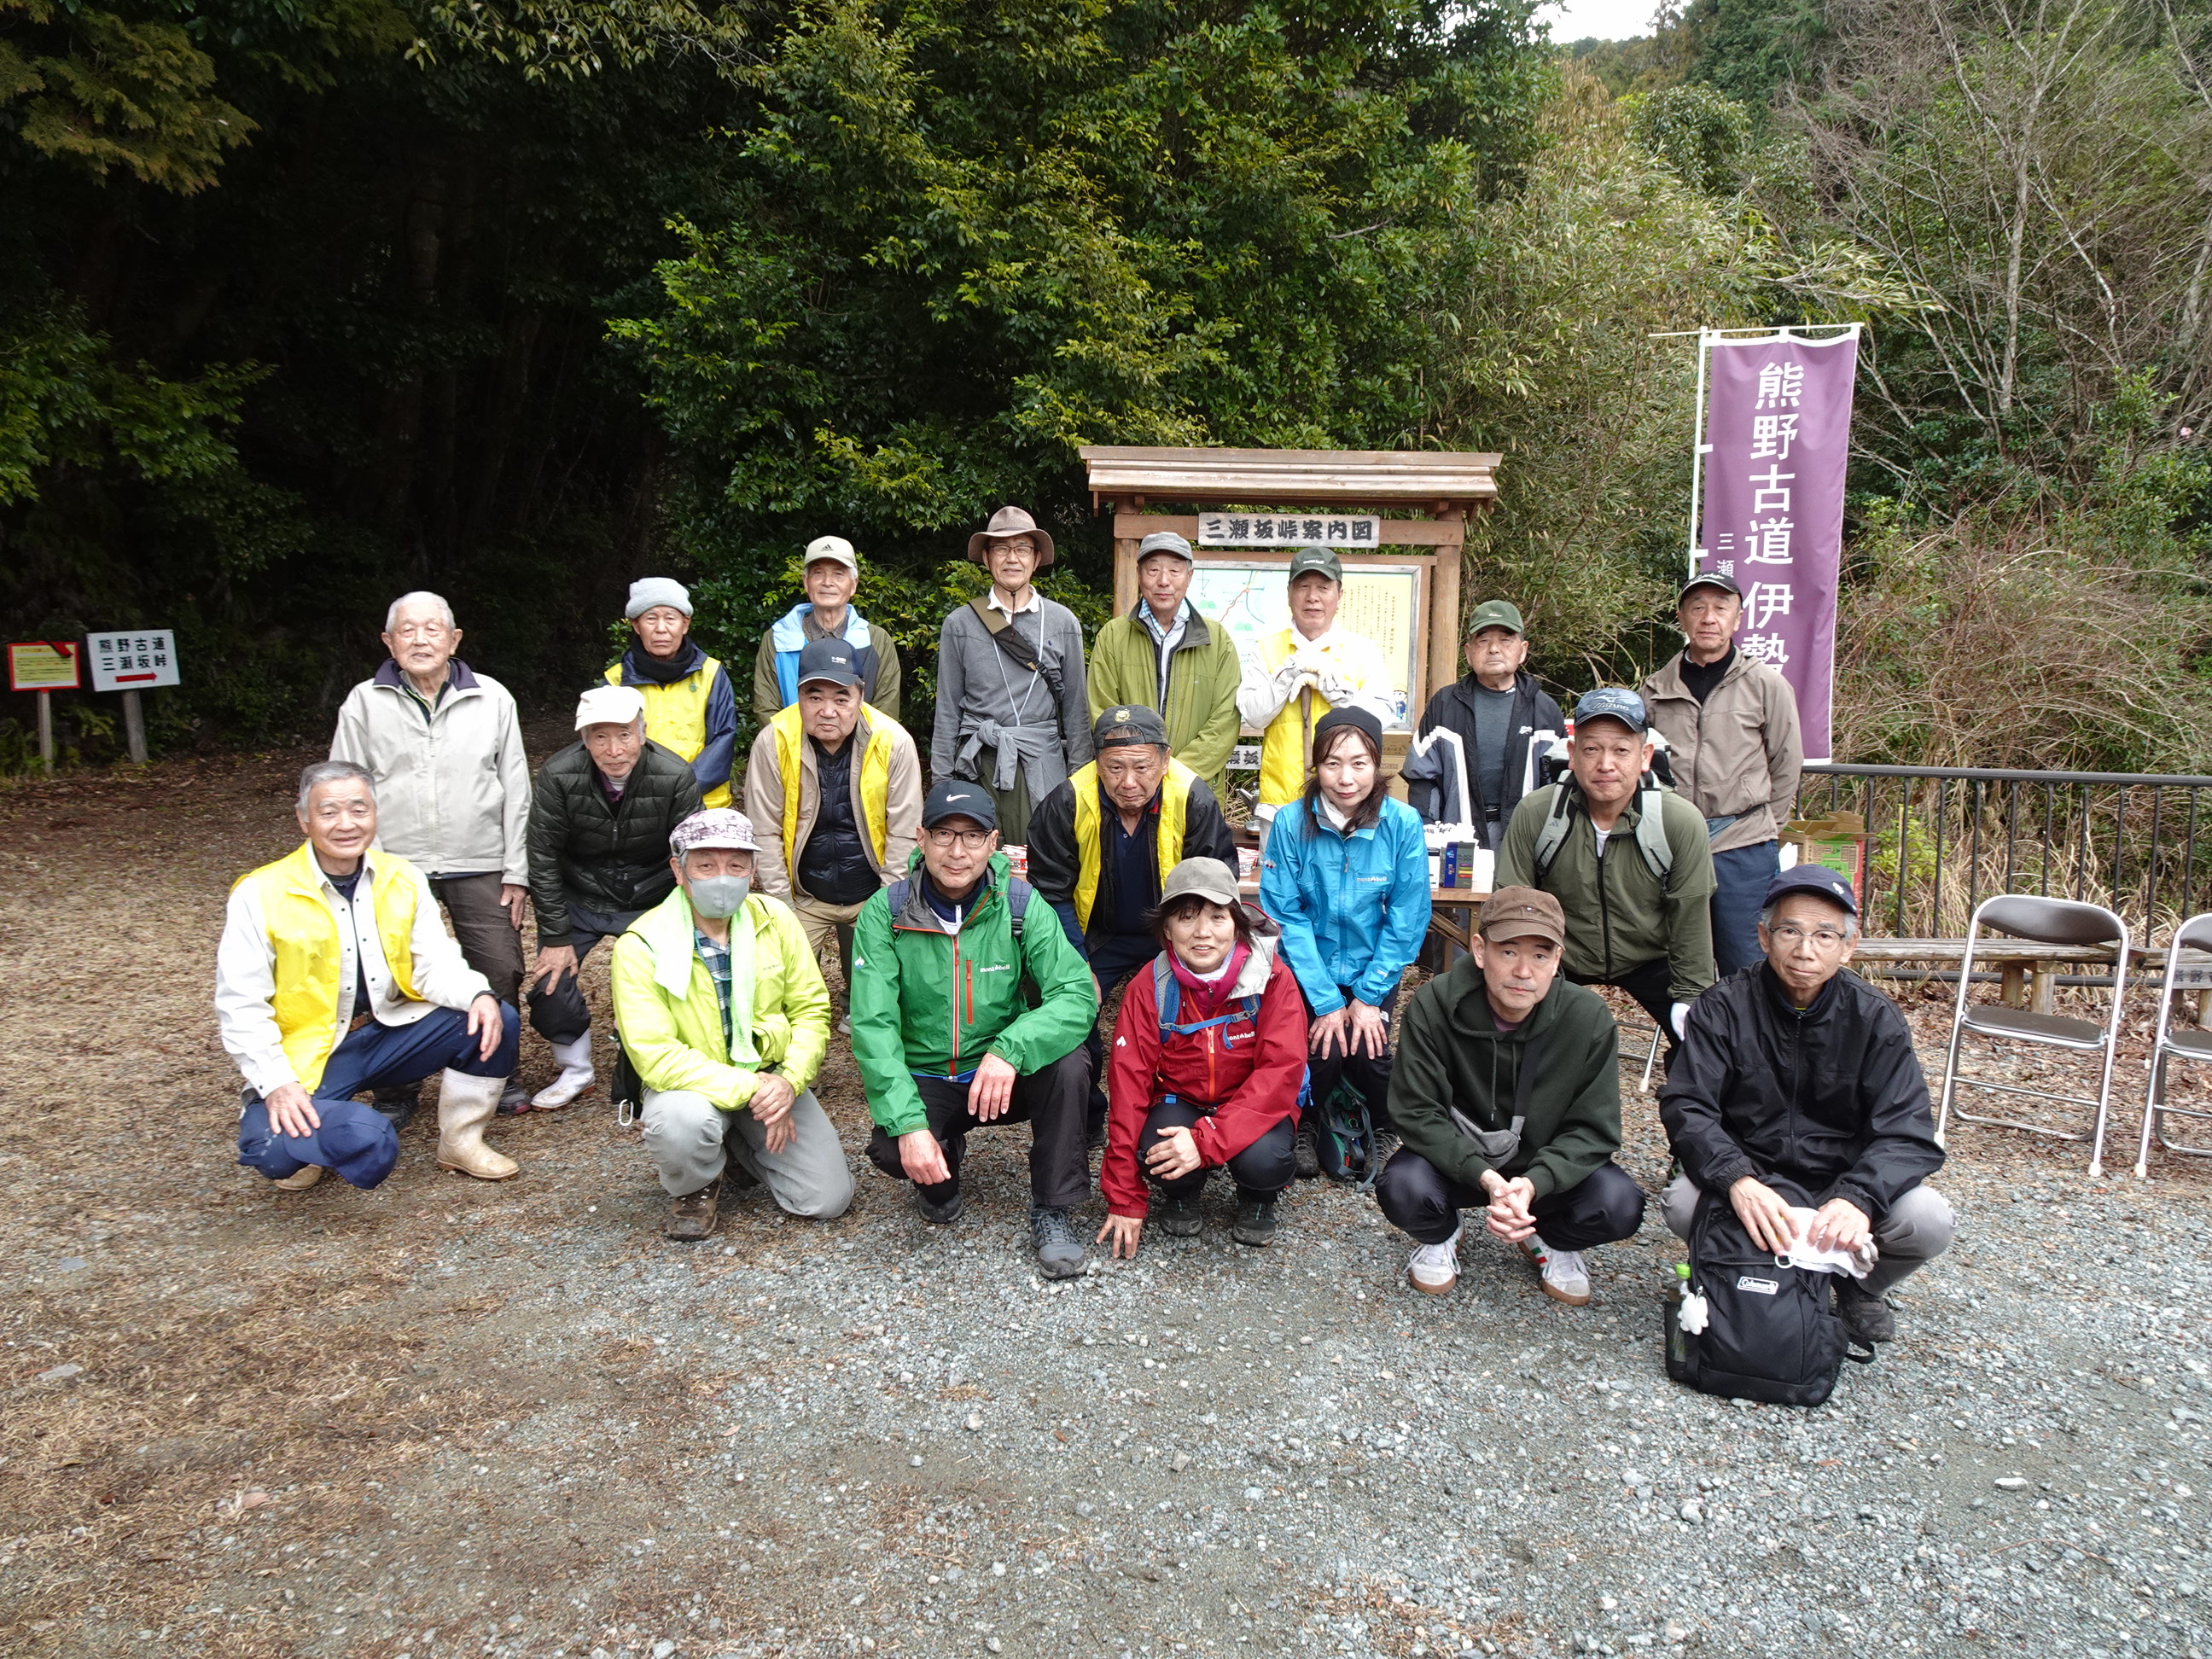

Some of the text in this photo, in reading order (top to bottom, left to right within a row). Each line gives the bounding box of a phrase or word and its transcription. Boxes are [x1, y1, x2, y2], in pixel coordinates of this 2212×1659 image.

[1205, 519, 1373, 541] 三瀬坂峠案内図
[98, 637, 166, 654] 熊野古道
[102, 654, 167, 671] 三瀬坂峠
